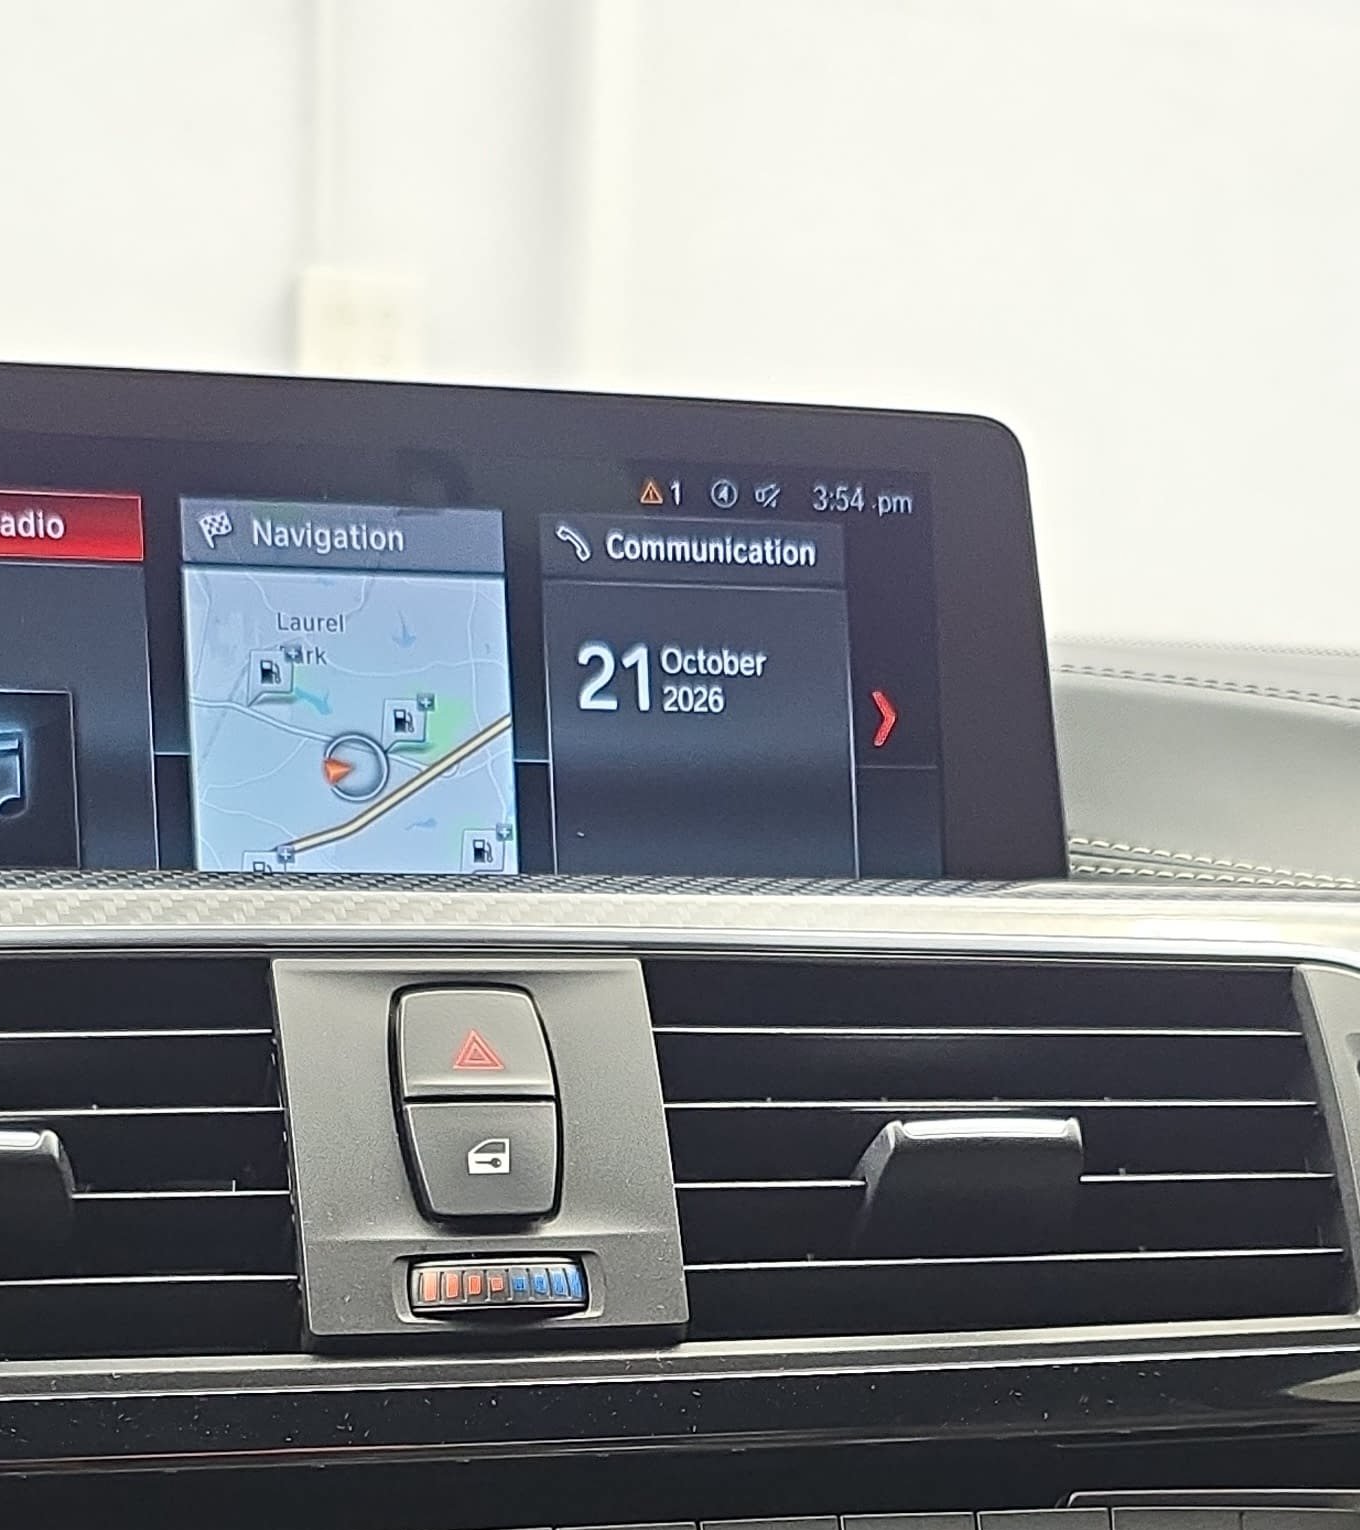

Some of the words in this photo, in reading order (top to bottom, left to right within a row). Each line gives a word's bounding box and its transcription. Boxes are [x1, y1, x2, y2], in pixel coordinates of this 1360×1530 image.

[670, 479, 681, 506] 1
[812, 485, 865, 513] 3:54
[877, 492, 913, 516] pm
[251, 519, 405, 555] Navigation
[606, 533, 817, 568] Communication
[277, 611, 344, 633] Laurel
[280, 645, 327, 665] ark
[577, 644, 652, 712] 21
[661, 648, 767, 677] October
[663, 686, 725, 713] 2026
